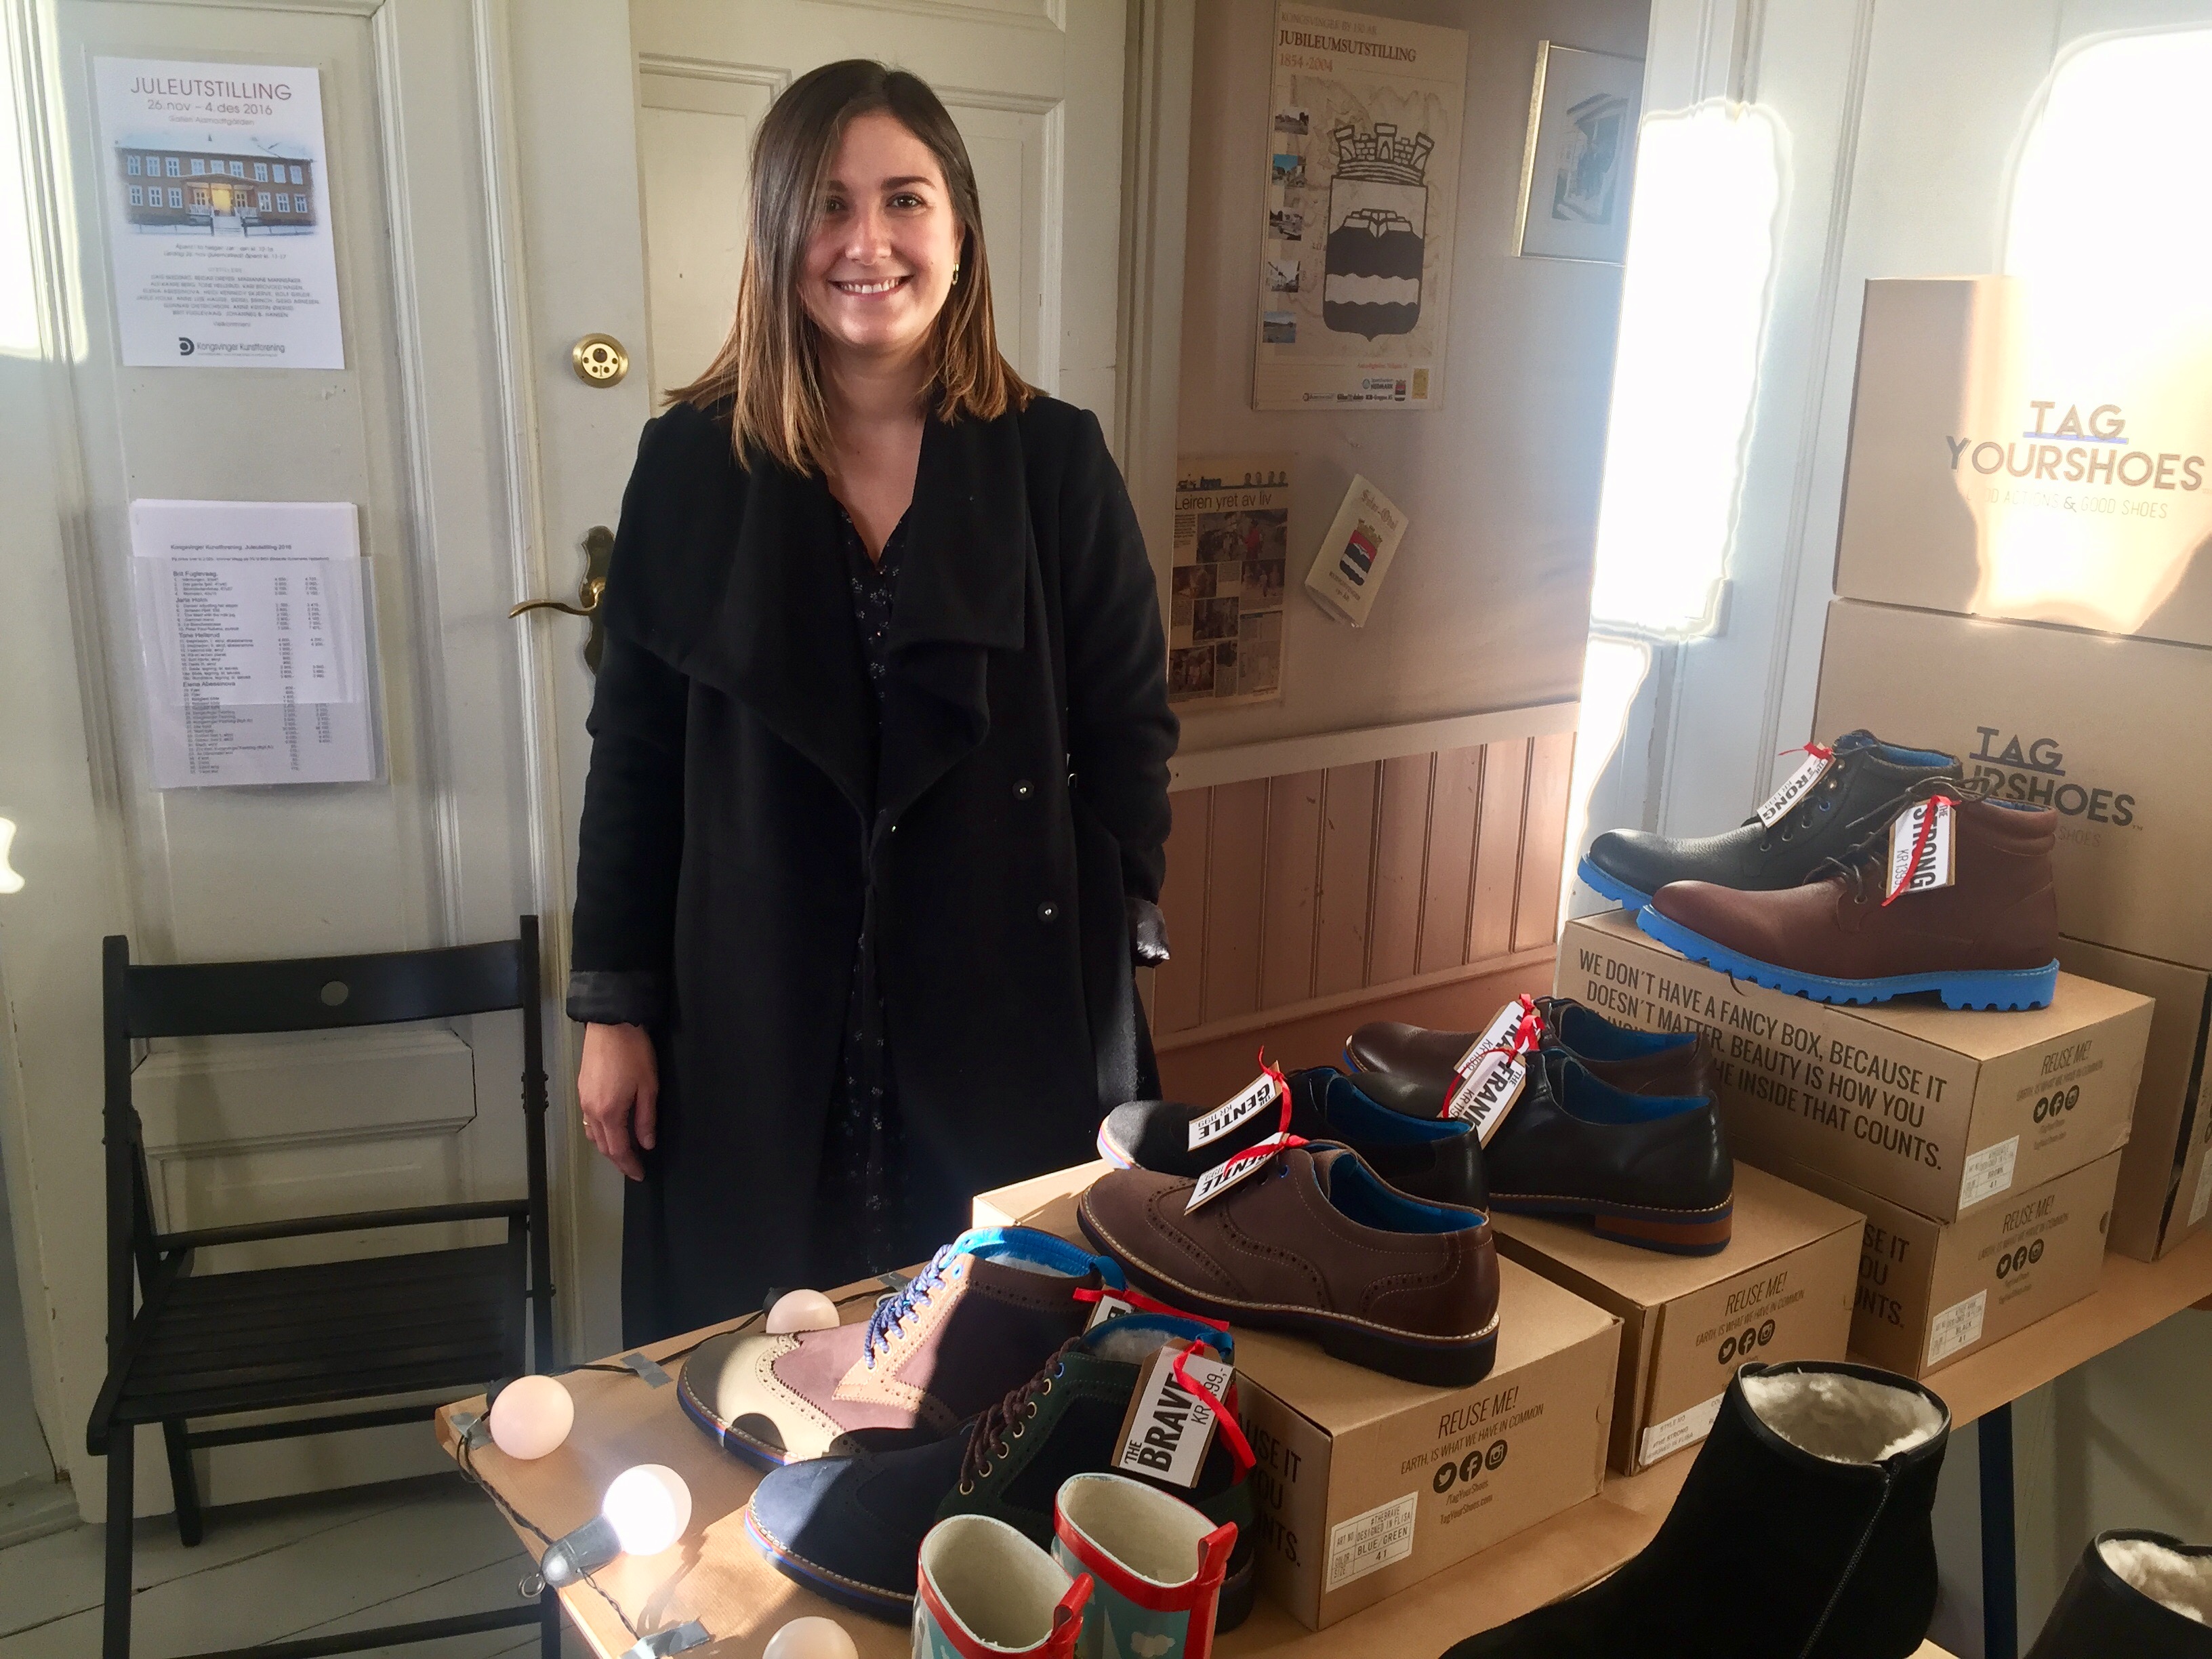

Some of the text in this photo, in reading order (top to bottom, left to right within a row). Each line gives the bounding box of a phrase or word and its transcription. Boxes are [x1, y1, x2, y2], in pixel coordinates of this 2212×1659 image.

[1279, 30, 1417, 63] JUBILEUMSUTSTILLING
[130, 77, 292, 100] JULEUTSTILLING
[244, 103, 272, 115] 2016
[2030, 400, 2126, 441] TAG
[1946, 435, 2207, 492] YOURSHOES
[1174, 494, 1212, 510] Leiren
[1216, 493, 1238, 511] yret
[1242, 495, 1256, 507] av
[2063, 495, 2077, 513] &
[2081, 496, 2116, 515] GOOD
[2121, 500, 2169, 519] SHOES
[1976, 726, 2064, 771] TAG
[1580, 948, 1948, 1103] WE DON'T HAVE A FANCY BOX, BECAUSE IT
[1586, 980, 1656, 1023] DOESN'T
[1730, 1035, 1802, 1080] BEAUTY
[1805, 1063, 1824, 1090] IS
[1828, 1072, 1877, 1109] HOW
[1883, 1090, 1925, 1128] YOU
[2041, 1045, 2076, 1076] REUSE
[1197, 1083, 1271, 1141] GENTLE
[1460, 1088, 1475, 1104] KR
[1738, 1068, 1799, 1113] INSIDE
[1803, 1092, 1851, 1131] THAT
[1853, 1115, 1942, 1170] COUNTS.
[2002, 1202, 2036, 1233] REUSE
[1890, 1235, 1910, 1263] IT
[1860, 1254, 1889, 1286] OU
[1725, 1271, 1788, 1317] REUSE ME!
[1136, 1372, 1193, 1473] BRAVE
[1190, 1404, 1212, 1425] KR
[1437, 1385, 1519, 1439] REUSE ME!
[1431, 1448, 1439, 1462] IS
[1441, 1436, 1465, 1458] WHAT
[1465, 1431, 1477, 1448] WE
[1477, 1422, 1499, 1443] HAVE
[1498, 1418, 1508, 1433] IN
[1508, 1403, 1544, 1429] COMMON
[1124, 1439, 1143, 1465] THE
[1284, 1448, 1302, 1483] IT
[1257, 1469, 1284, 1511] OU
[1439, 1494, 1493, 1525] TagYourShoes.com
[1357, 1526, 1408, 1556] BLUE/GREEN
[1376, 1549, 1387, 1561] 41
